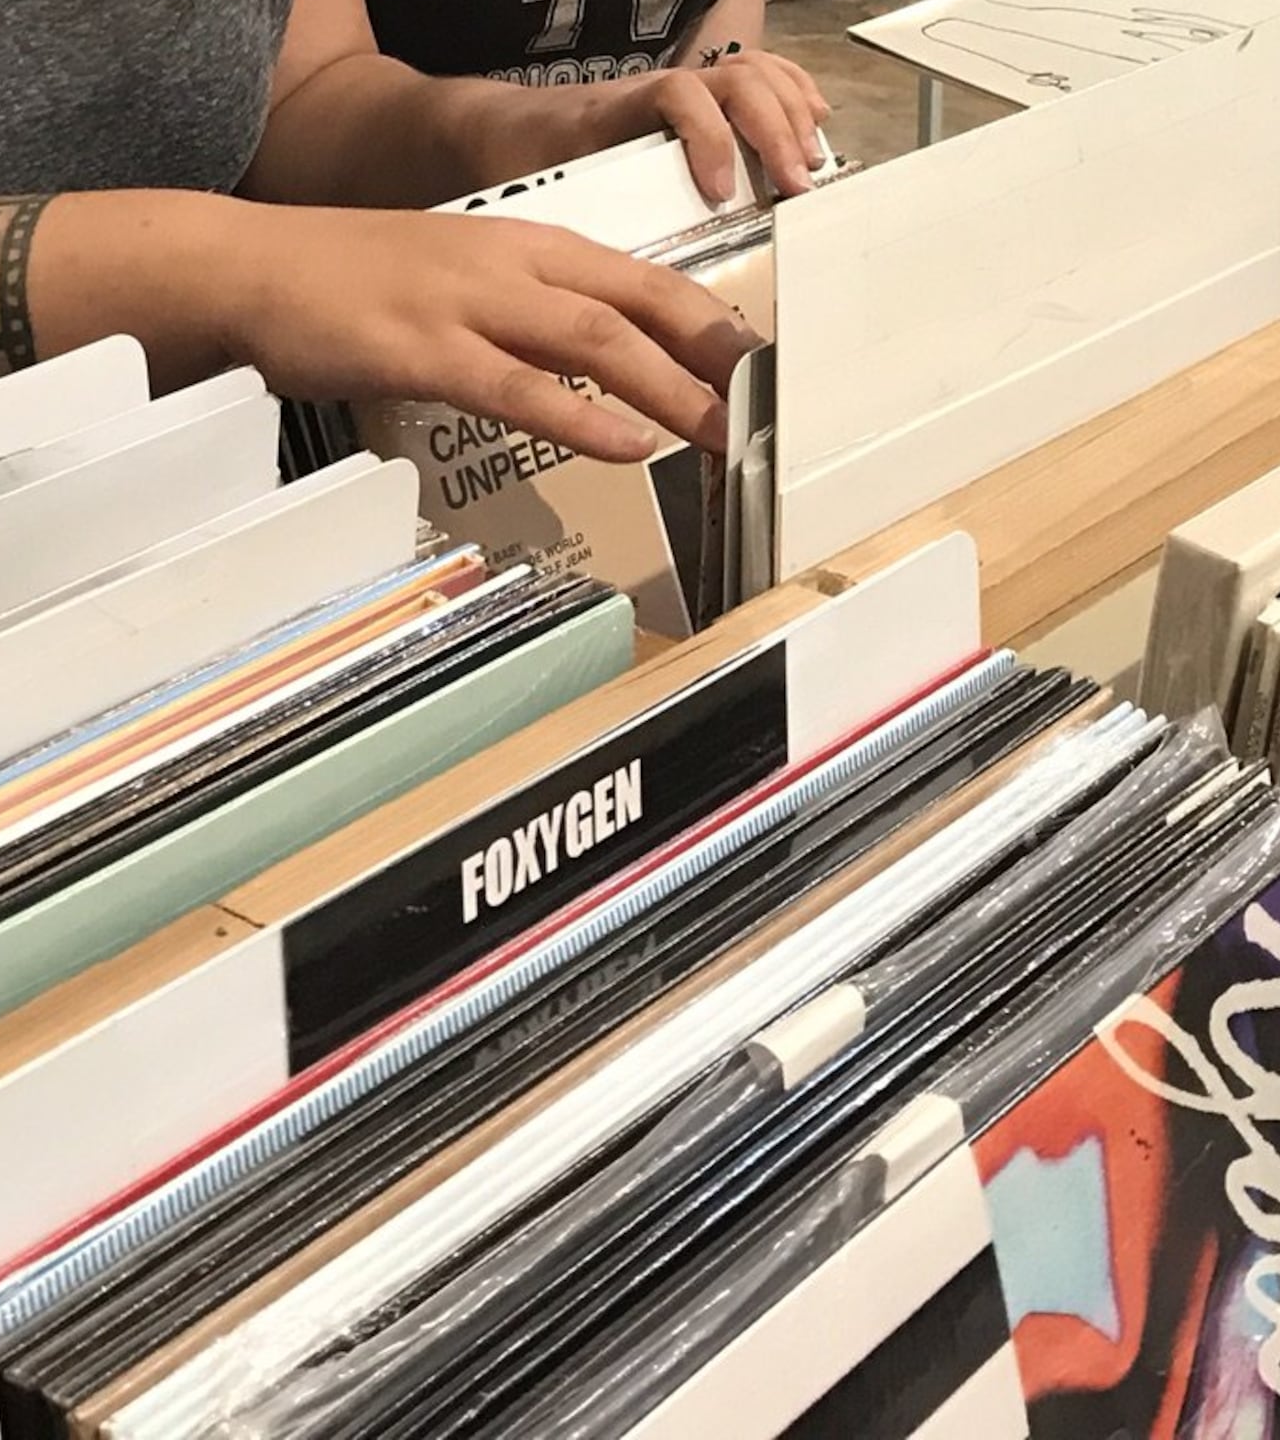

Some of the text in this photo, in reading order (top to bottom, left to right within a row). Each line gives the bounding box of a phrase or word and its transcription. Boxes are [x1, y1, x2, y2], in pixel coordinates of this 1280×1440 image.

[429, 415, 508, 464] CAG
[544, 532, 585, 558] WORLD
[565, 546, 593, 569] JEAN
[461, 758, 644, 924] FOXYGEN
